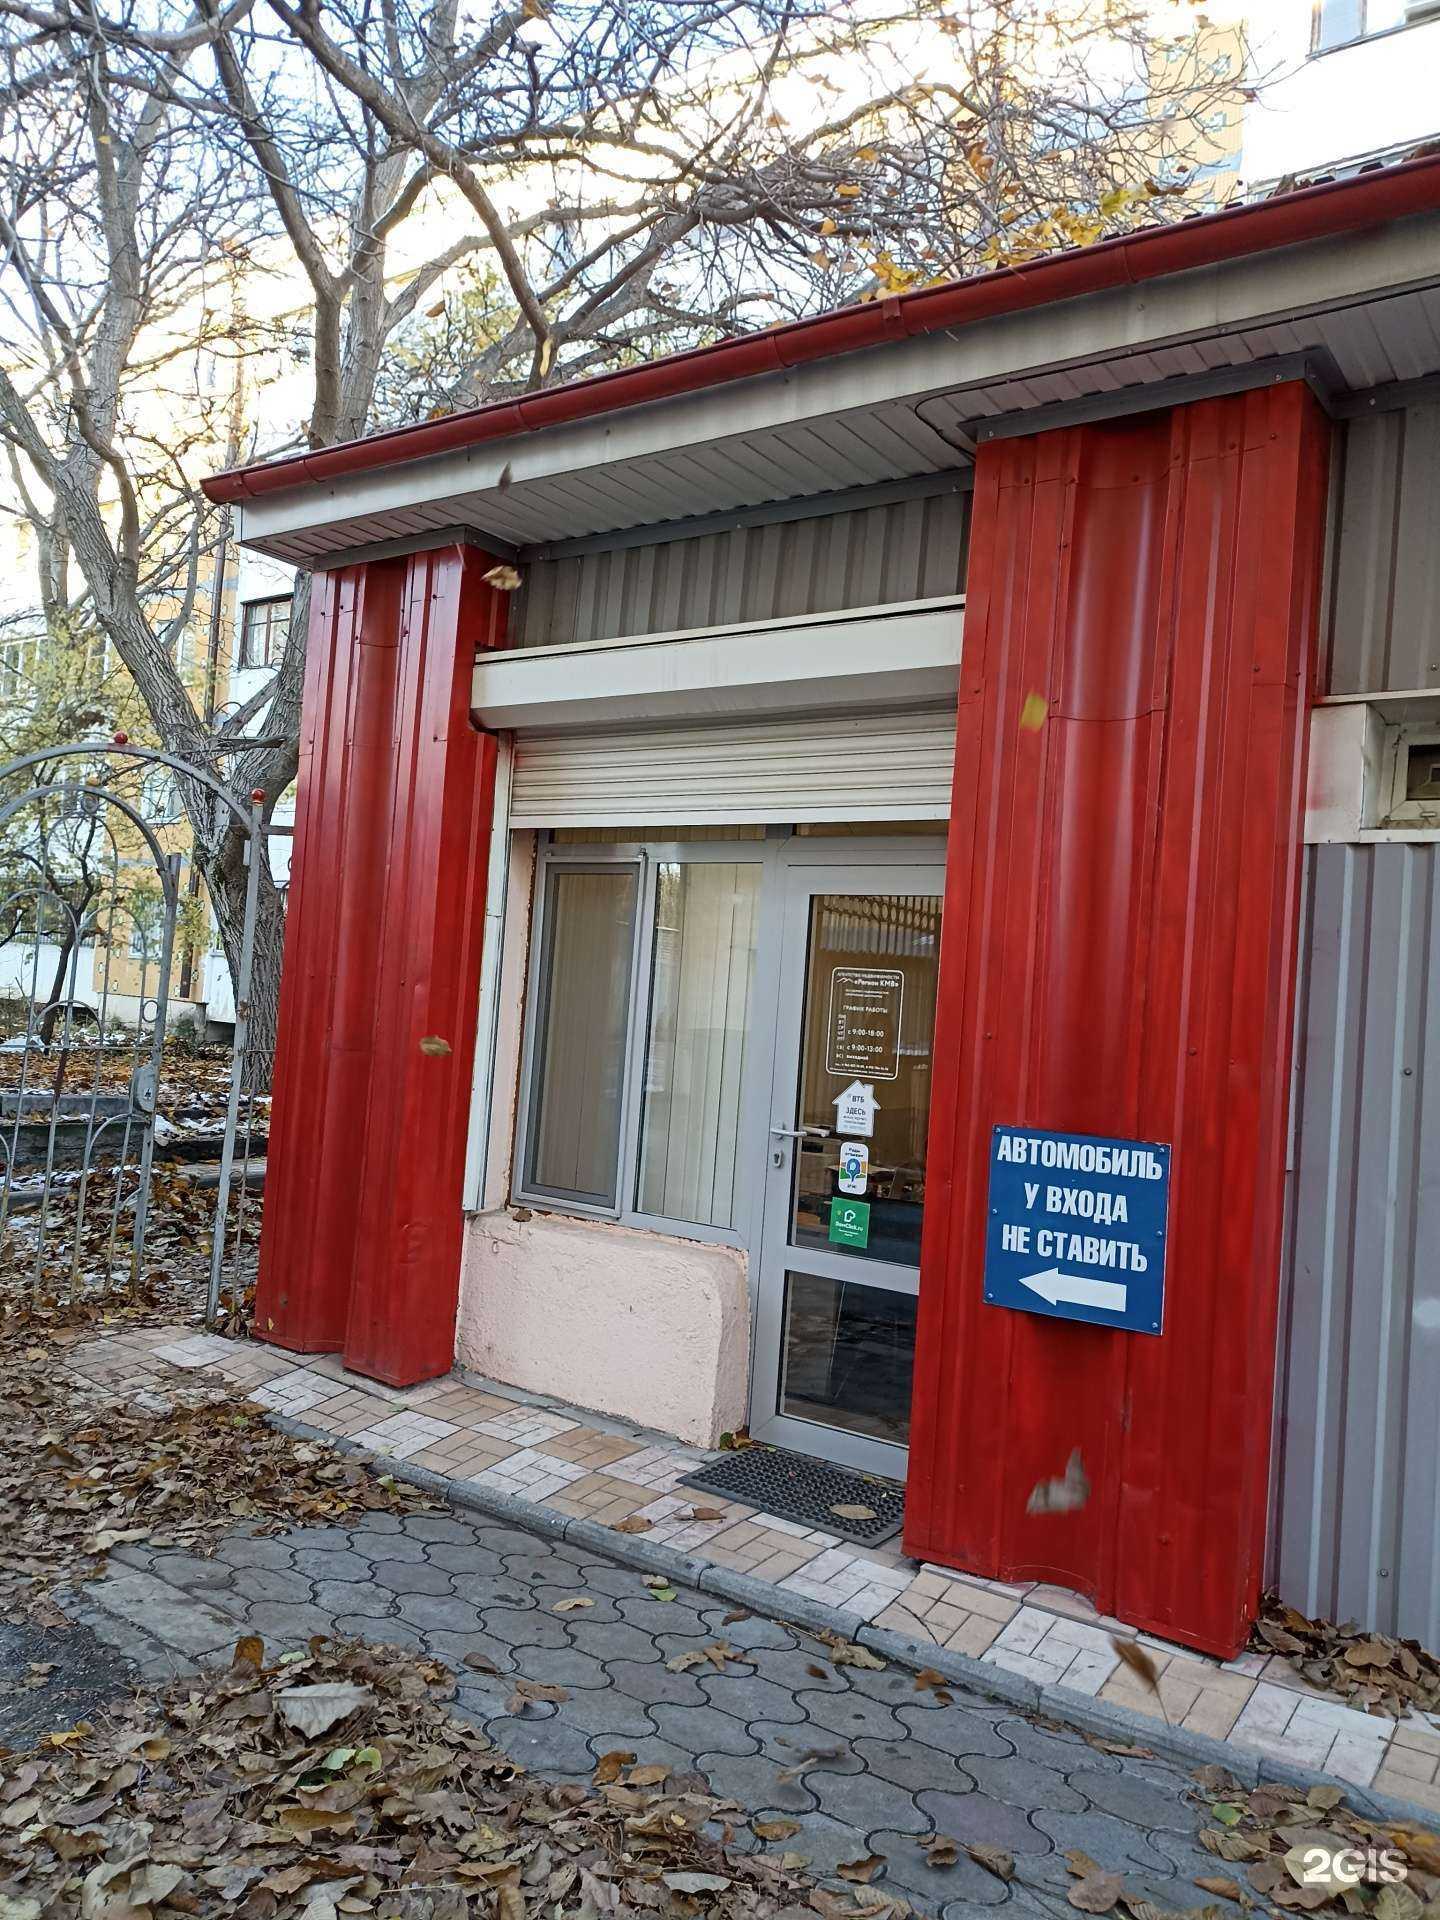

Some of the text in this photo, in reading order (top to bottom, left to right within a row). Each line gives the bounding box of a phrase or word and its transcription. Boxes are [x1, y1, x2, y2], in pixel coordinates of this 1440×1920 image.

[852, 1028, 885, 1038] 9:00-18:00
[851, 1044, 883, 1053] 9:00-13:00
[852, 1095, 865, 1103] ВТБ
[846, 1107, 866, 1115] ЗДЕСЬ
[997, 1135, 1163, 1180] АВТОМОБИЛЬ
[1024, 1182, 1128, 1226] У ВХОДА
[1001, 1223, 1148, 1272] НЕ СТАВИТЬ
